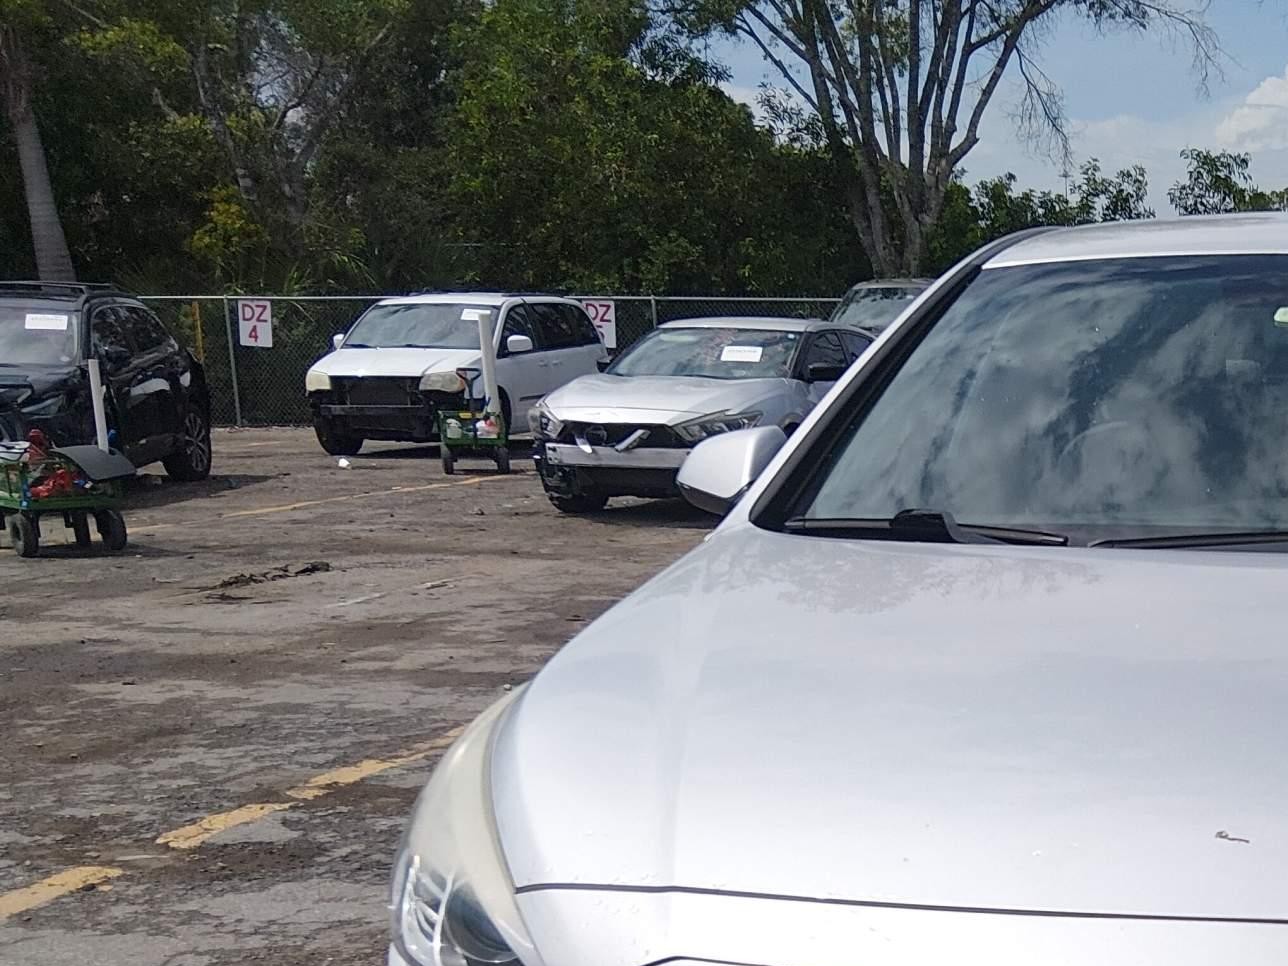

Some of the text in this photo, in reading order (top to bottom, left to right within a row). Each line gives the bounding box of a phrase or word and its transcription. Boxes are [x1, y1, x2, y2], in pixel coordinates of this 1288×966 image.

[242, 303, 268, 323] DZ
[585, 303, 612, 323] DZ
[248, 324, 259, 343] 4
